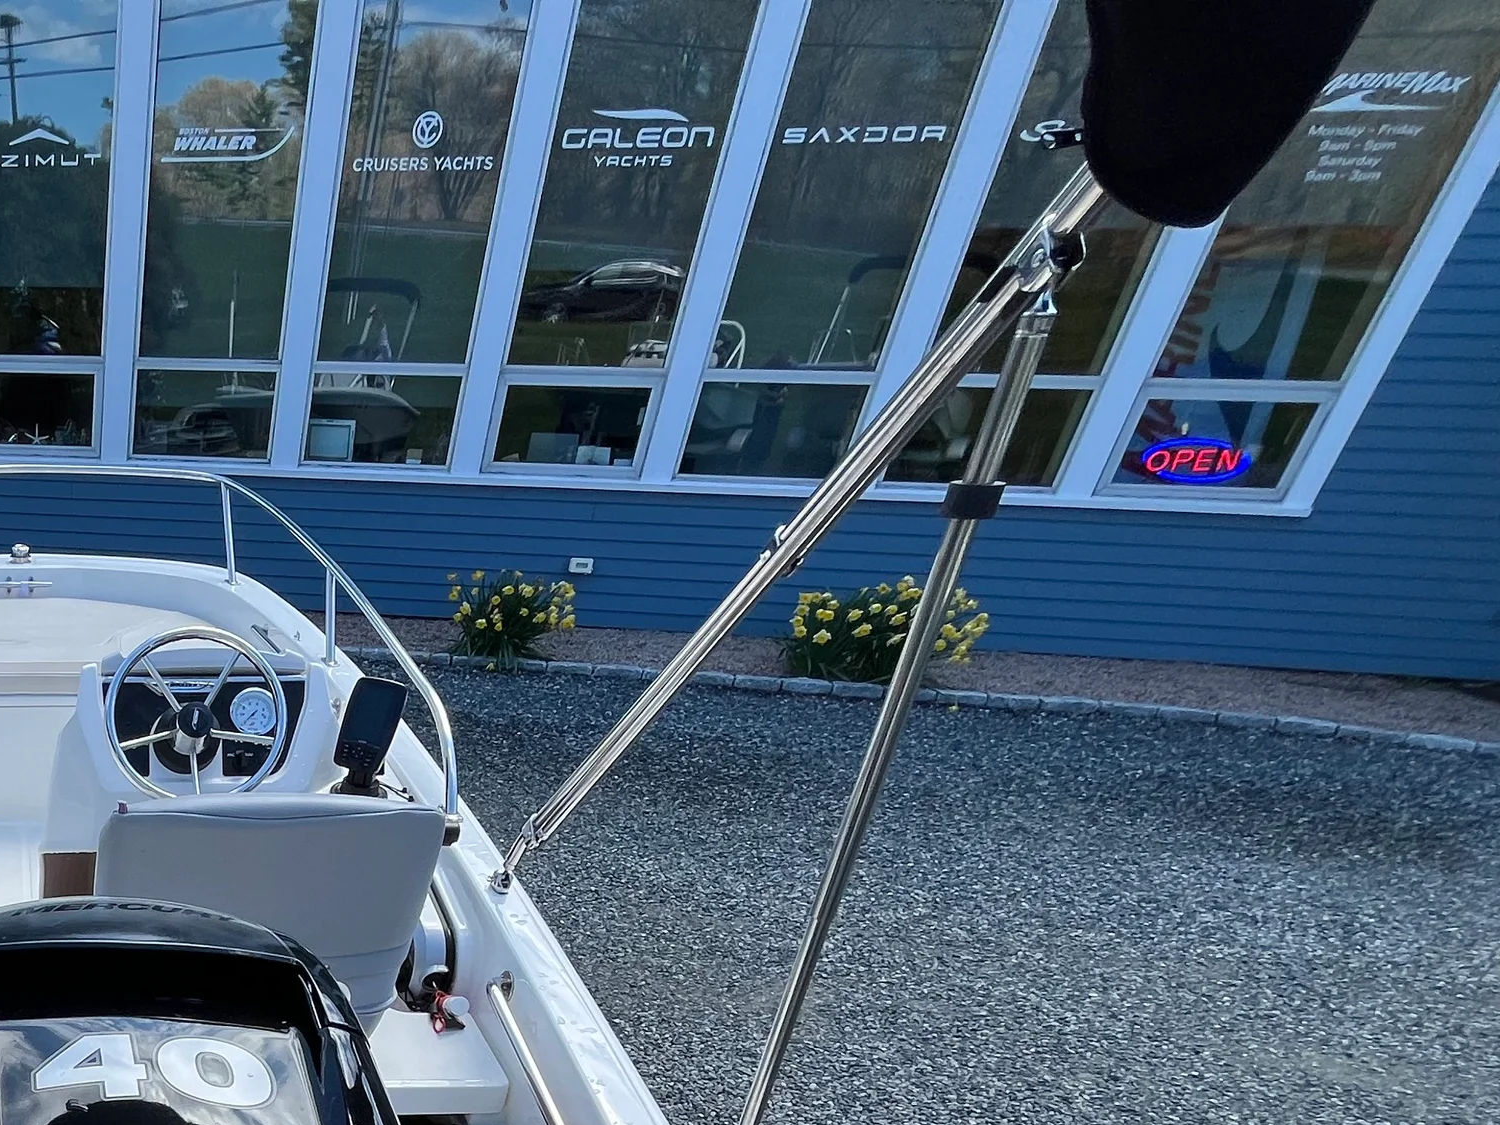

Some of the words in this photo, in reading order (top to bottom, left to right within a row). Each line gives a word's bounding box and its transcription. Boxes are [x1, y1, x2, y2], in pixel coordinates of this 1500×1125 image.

[561, 126, 715, 149] GALEON
[781, 125, 947, 145] SAXDOR
[1308, 124, 1367, 138] Monday
[1377, 124, 1425, 137] Friday
[174, 135, 257, 151] WHALER
[352, 156, 429, 172] CRUISERS
[434, 156, 494, 171] YACHTS
[594, 155, 673, 167] YACHTS
[1318, 155, 1382, 168] Saturday
[1146, 449, 1242, 472] OPEN
[30, 1032, 278, 1109] 40
